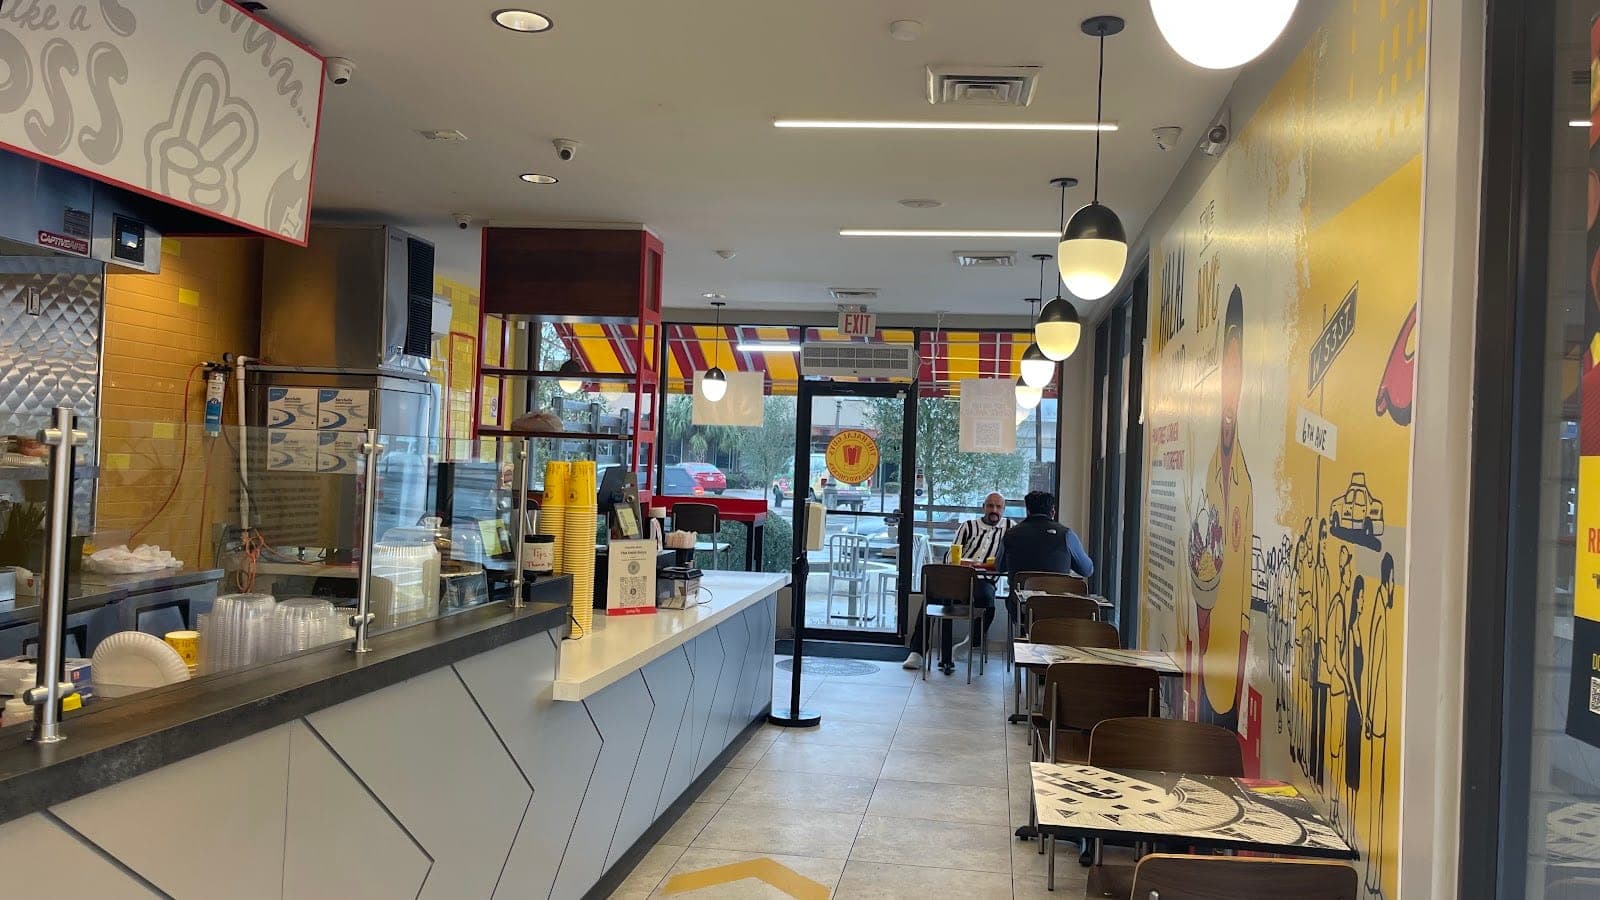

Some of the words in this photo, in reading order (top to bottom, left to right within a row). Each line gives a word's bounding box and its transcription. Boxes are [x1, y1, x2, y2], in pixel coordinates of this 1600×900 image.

[69, 4, 92, 31] a
[844, 314, 872, 335] EXIT
[1312, 344, 1322, 382] W
[1302, 417, 1316, 443] 6TH
[1315, 426, 1328, 451] AVE
